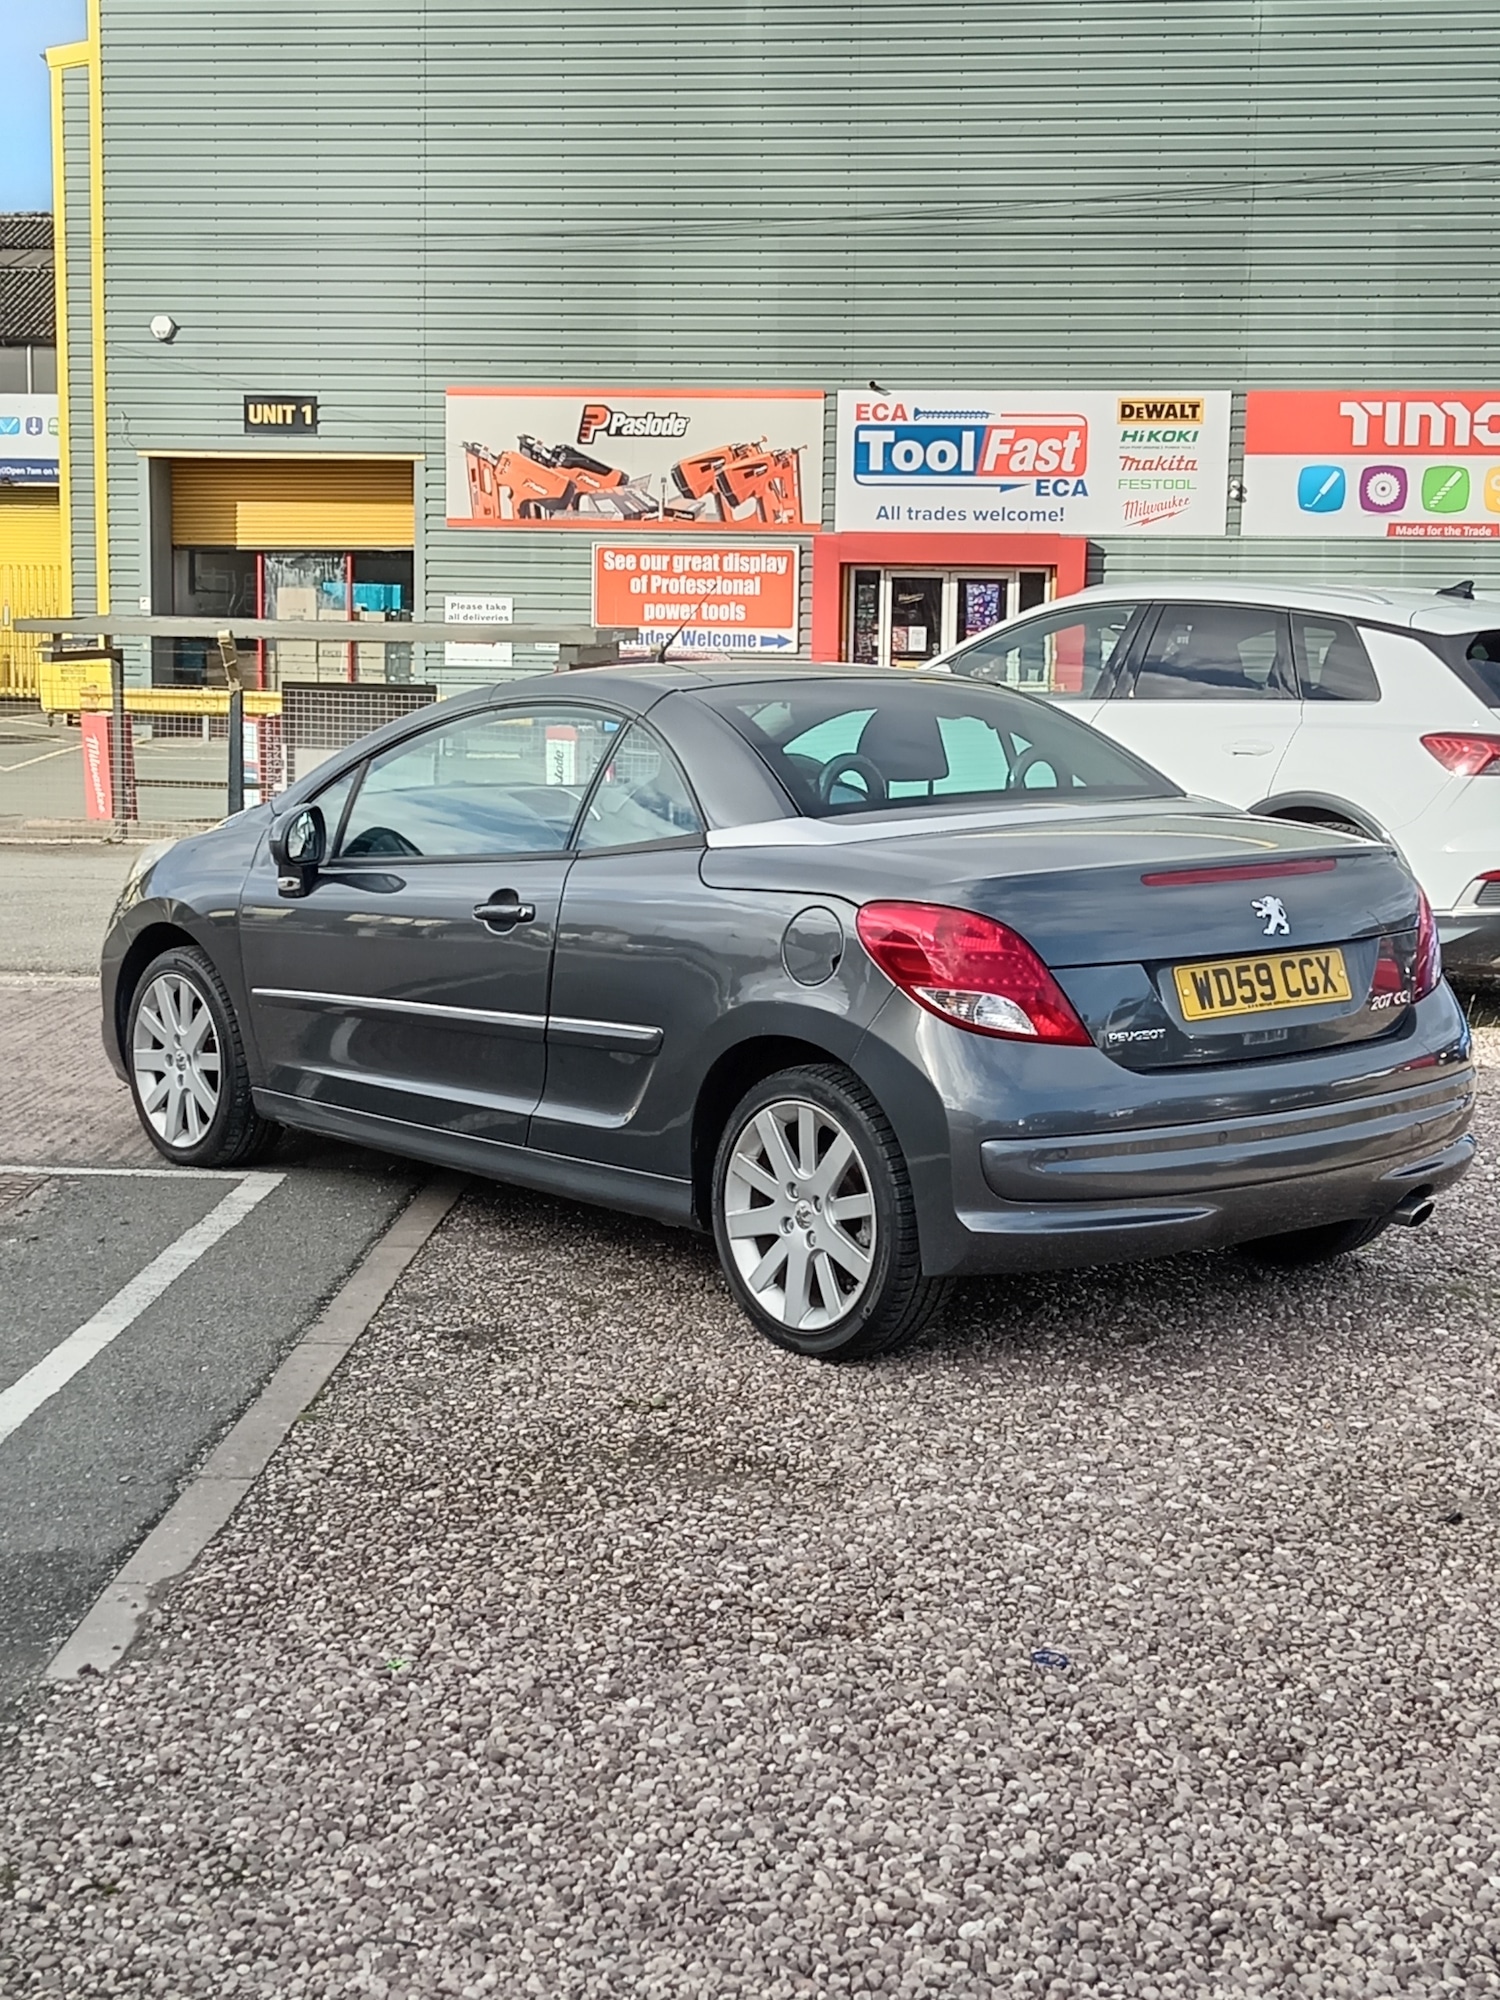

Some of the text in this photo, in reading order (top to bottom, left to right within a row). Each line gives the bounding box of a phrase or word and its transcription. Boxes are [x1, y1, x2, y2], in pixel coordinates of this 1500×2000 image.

[248, 404, 313, 425] UNIT 1
[855, 403, 908, 422] ECA
[607, 411, 690, 438] Paslode
[858, 428, 1082, 473] Tool Fast
[1035, 478, 1089, 497] ECA
[1118, 478, 1197, 490] FESTOOL
[876, 505, 1065, 522] All trades welcome!
[1121, 495, 1191, 521] Milwaukee
[1395, 524, 1493, 537] Made for the Trade
[603, 550, 788, 576] See our great display
[630, 575, 761, 596] of Professional
[450, 602, 508, 612] Please take
[643, 601, 747, 622] power tools
[448, 613, 510, 622] all deliveries
[681, 630, 758, 648] Welcome
[1190, 955, 1338, 1011] WD59 CGX
[1370, 992, 1394, 1011] 207
[1108, 1028, 1167, 1043] PEUGEOT
